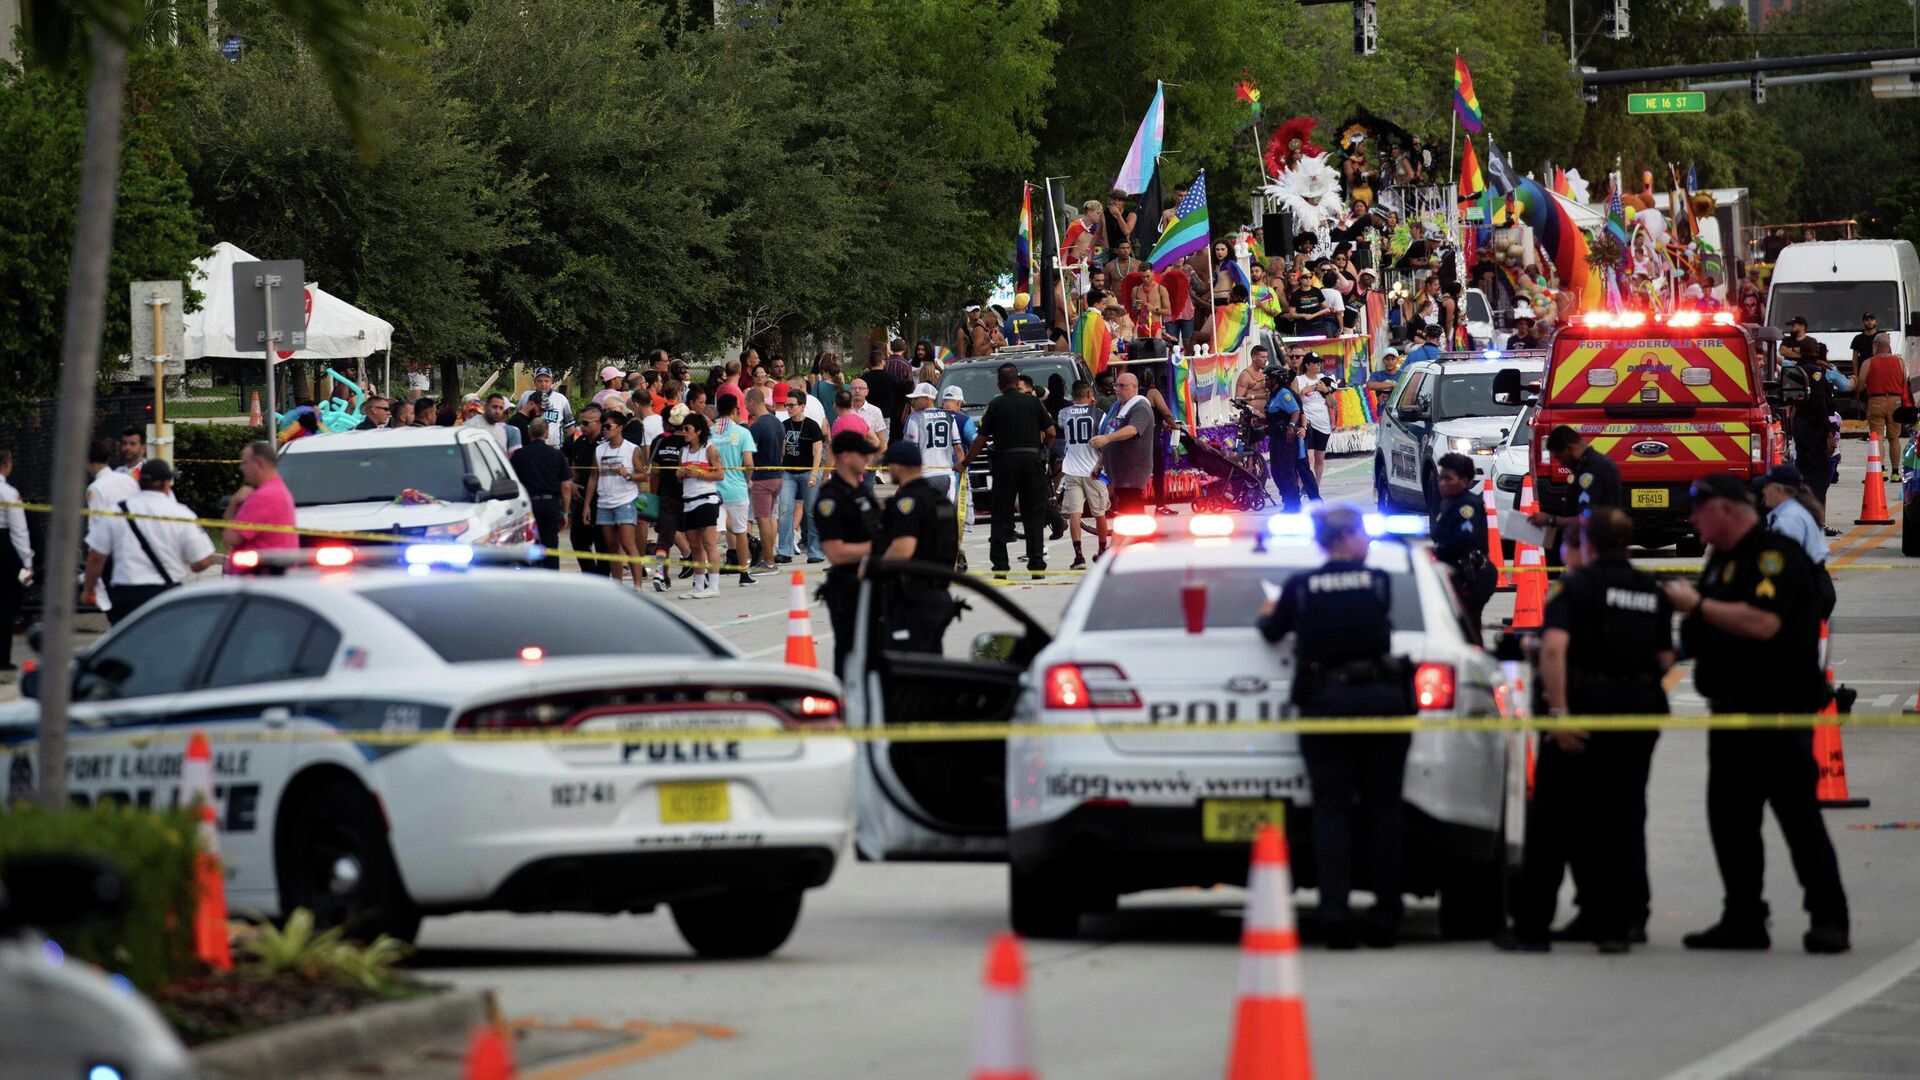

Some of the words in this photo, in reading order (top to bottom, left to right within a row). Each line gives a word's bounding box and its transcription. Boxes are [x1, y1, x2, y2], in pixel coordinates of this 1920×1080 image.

[1645, 97, 1657, 109] NE
[1662, 97, 1671, 108] 16
[1676, 96, 1687, 108] ST
[1580, 340, 1610, 349] FORT
[1613, 340, 1691, 349] LAUDERDALE
[1696, 339, 1723, 348] FIRE
[925, 420, 949, 449] 19
[1066, 416, 1093, 445] 10
[1637, 494, 1663, 504] XF6419
[1308, 570, 1372, 595] POLICE
[1606, 587, 1658, 613] POLICE
